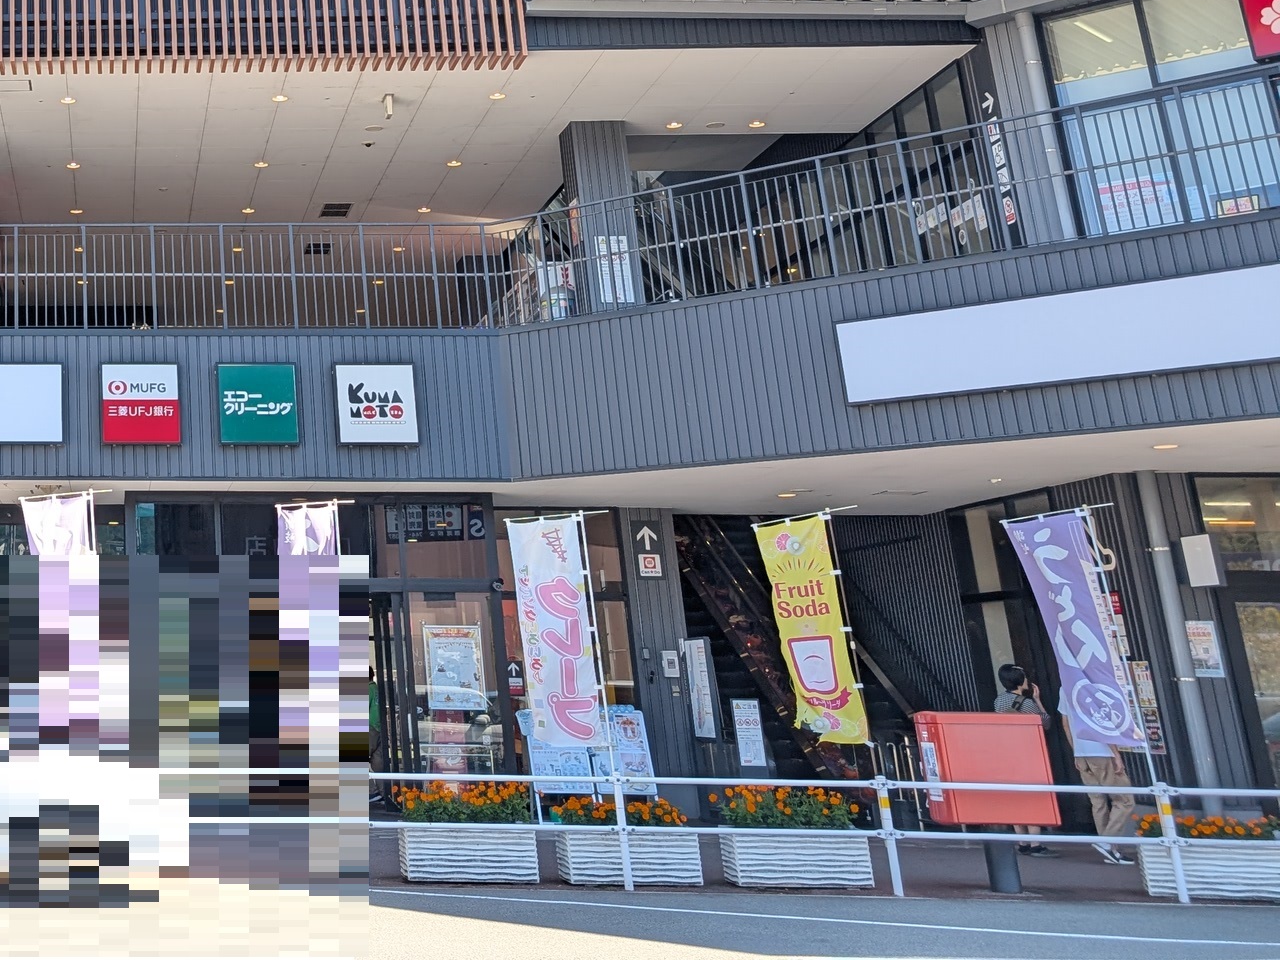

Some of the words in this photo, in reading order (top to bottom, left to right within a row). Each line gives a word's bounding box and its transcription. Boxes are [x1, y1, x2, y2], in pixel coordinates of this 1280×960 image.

[130, 383, 167, 393] MUFG
[223, 391, 262, 402] エコー
[108, 406, 174, 417] 三菱UFJ銀行
[223, 402, 293, 415] クリーニング
[774, 579, 825, 600] Fruit
[777, 598, 831, 619] Soda
